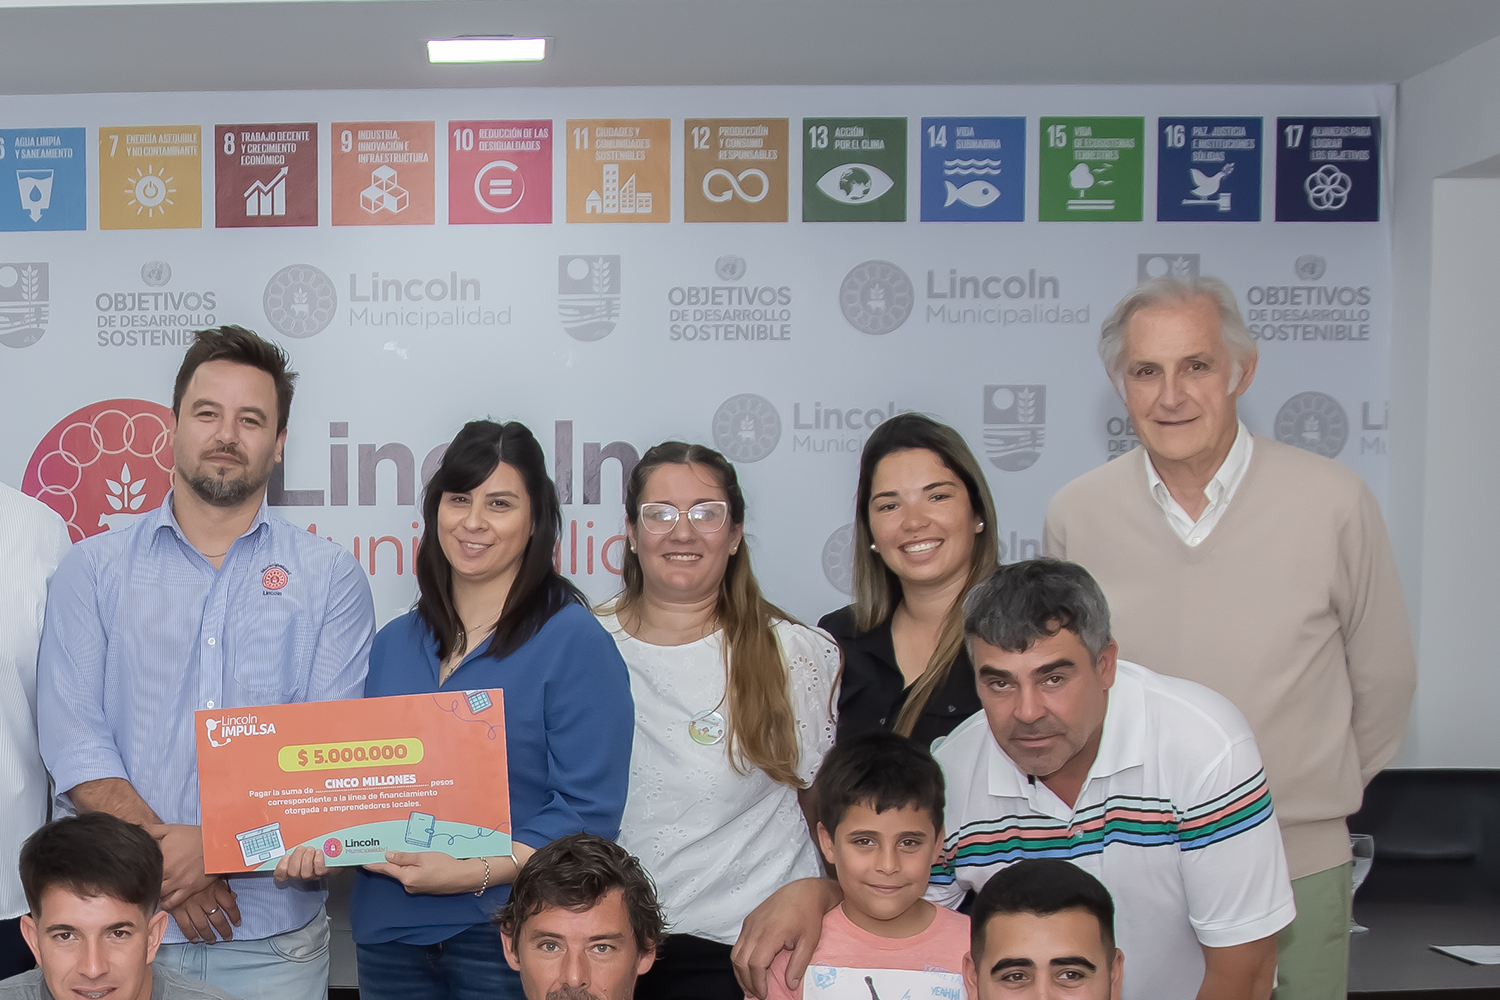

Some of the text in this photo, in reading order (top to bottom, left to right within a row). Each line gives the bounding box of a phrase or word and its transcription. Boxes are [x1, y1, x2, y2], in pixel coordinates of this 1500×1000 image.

[15, 136, 61, 147] AGUA LIMPIA
[126, 133, 198, 145] ENERGÍA ASEQUIBLE
[241, 130, 310, 142] TRABAJO DECENTE
[341, 130, 353, 152] 9
[454, 128, 474, 151] 10
[479, 127, 549, 139] REDUCCIÓN DE LAS
[573, 127, 589, 149] 11
[691, 126, 710, 149] 12
[809, 126, 829, 149] 13
[927, 125, 948, 148] 14
[1047, 125, 1067, 148] 15
[1165, 125, 1185, 148] 16
[1284, 125, 1304, 148] 17
[109, 134, 119, 157] 7
[143, 146, 198, 156] CONTAMINANTE
[224, 132, 235, 155] 8
[247, 143, 297, 154] CRECIMIENTO
[358, 140, 403, 152] INNOVACIÓN
[479, 140, 541, 151] DESIGUALDADES
[835, 139, 885, 150] POR CLIMA
[21, 148, 73, 159] SANEAMIENTO
[241, 154, 285, 166] ECONÓMICO
[358, 152, 429, 164] INFRAESTRUCTURA
[718, 150, 778, 160] RESPONSABLES
[349, 270, 481, 302] Lincoln
[927, 268, 1059, 299] Lincoln
[95, 291, 216, 312] OBJETIVOS
[668, 286, 791, 306] OBJETIVOS
[1246, 285, 1371, 306] OBJETIVOS
[97, 312, 216, 327] DE DESARROLLO
[349, 305, 512, 330] Municipalidad
[670, 308, 791, 322] DE DESARROLLO
[926, 303, 1090, 327] Municipalidad
[1249, 308, 1370, 322] DE DESARROLLO
[670, 324, 791, 341] SOSTENIBLE
[1249, 324, 1370, 341] SOSTENIBLE
[222, 713, 257, 727] Lincoln
[221, 723, 276, 738] IMPULSA
[297, 744, 408, 767] $ 5.000.000
[249, 790, 271, 798] Pagar
[430, 779, 454, 787] pesos
[325, 774, 417, 789] CINCO MILLONES
[267, 796, 331, 806] correspondiente
[379, 789, 438, 799] financiamiento
[284, 800, 422, 815] otorgada emprendedores locales.
[345, 837, 380, 847] Lincoln
